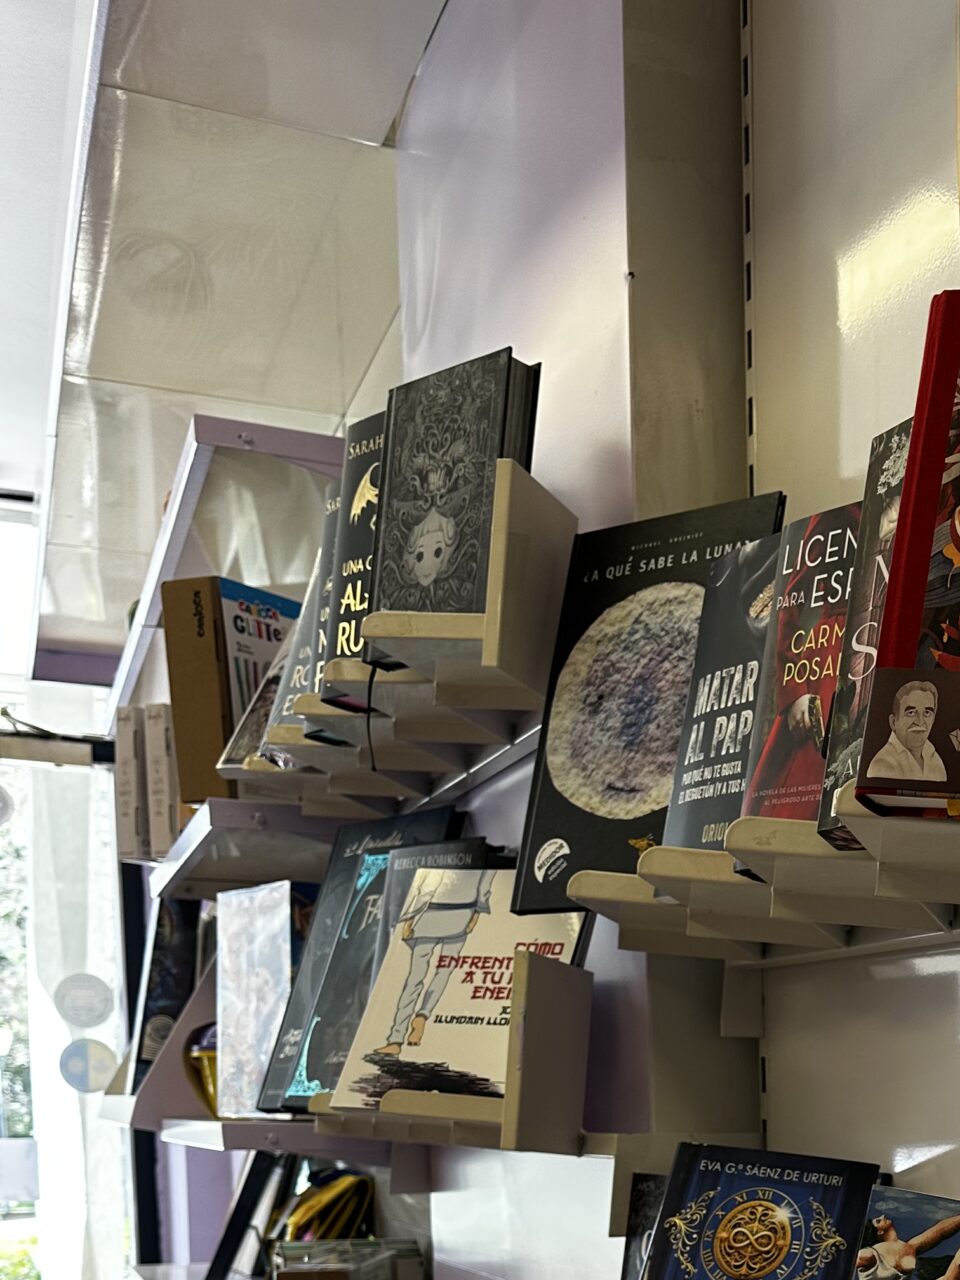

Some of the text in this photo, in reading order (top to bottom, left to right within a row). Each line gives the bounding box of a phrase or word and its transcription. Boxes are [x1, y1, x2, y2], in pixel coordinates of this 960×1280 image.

[348, 434, 384, 460] SARAH
[342, 558, 364, 577] UNA
[605, 556, 633, 580] QUÉ
[638, 554, 675, 573] SABE
[681, 550, 699, 564] LA
[776, 590, 805, 611] PARA
[693, 660, 760, 719] MATAR
[684, 721, 706, 766] AL
[461, 971, 500, 985] A TU
[700, 1159, 843, 1187] EVA SÁENZ DE URTURI
